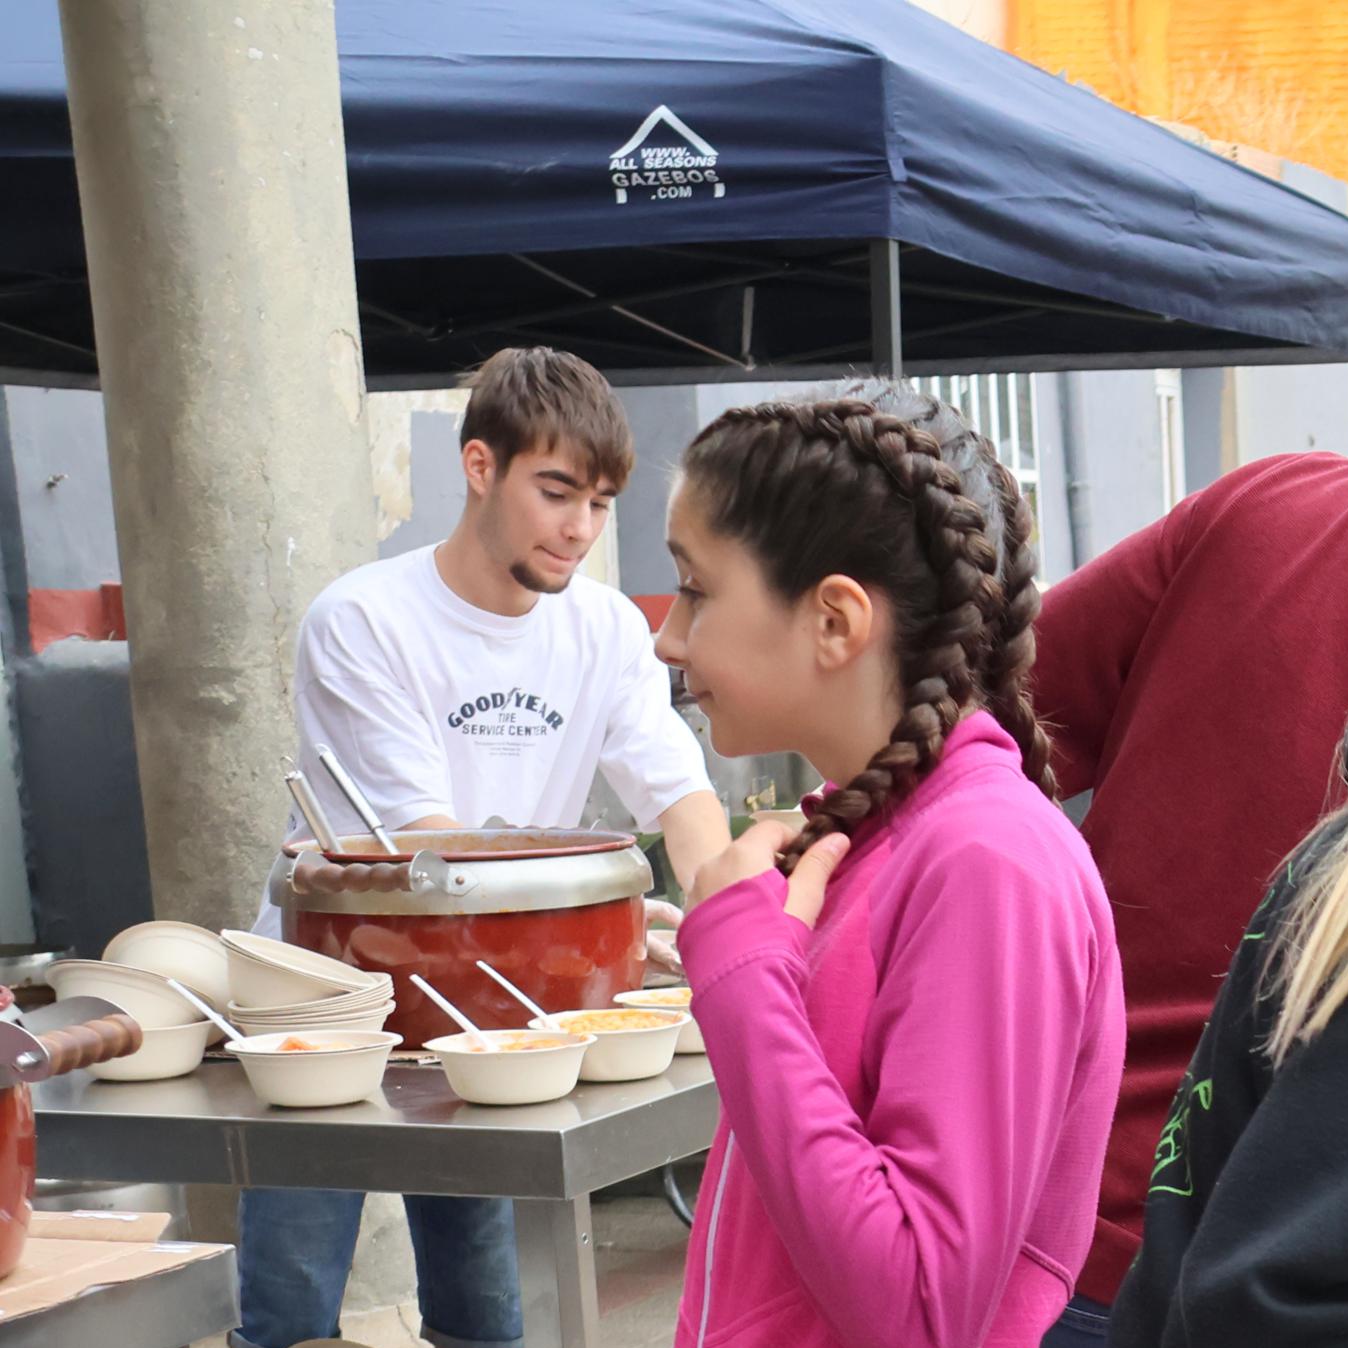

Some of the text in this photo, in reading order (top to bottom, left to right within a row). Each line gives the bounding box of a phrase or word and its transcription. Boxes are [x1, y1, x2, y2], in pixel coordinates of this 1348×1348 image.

[609, 155, 717, 171] ALL SEASONS
[611, 169, 719, 187] GAZEBOS
[650, 186, 692, 201] .COM
[462, 723, 547, 737] SERVICE CENTER
